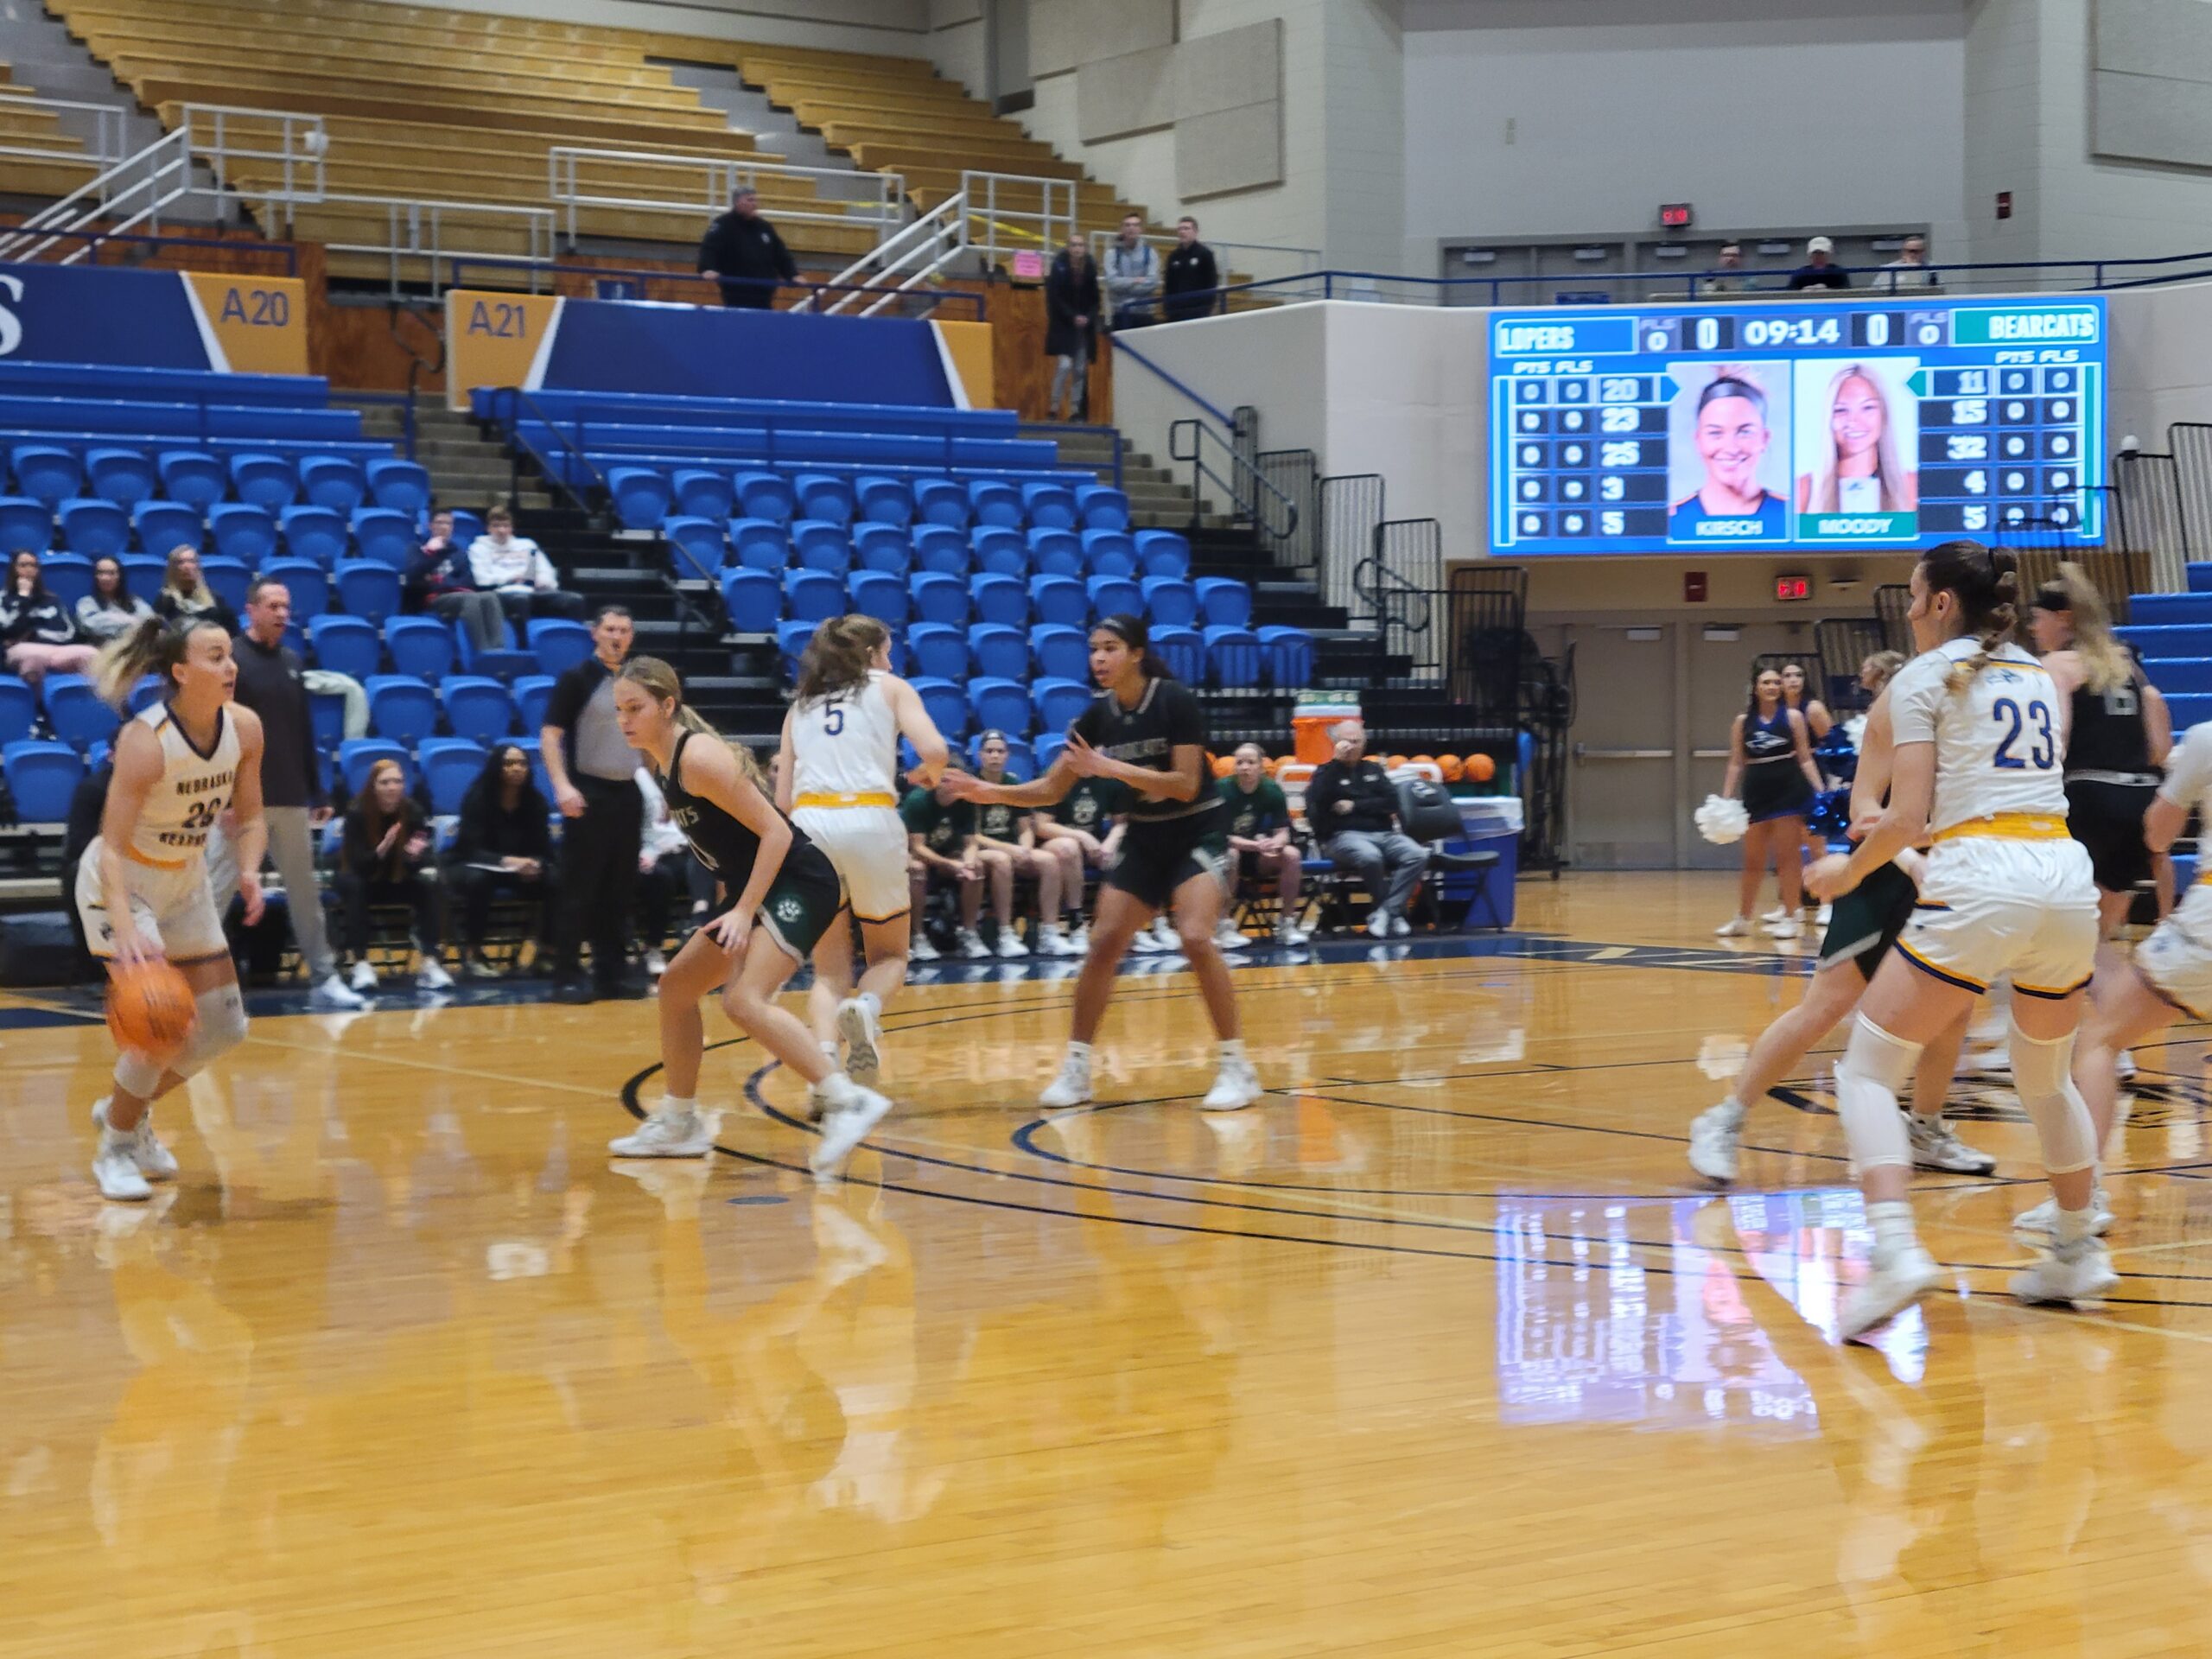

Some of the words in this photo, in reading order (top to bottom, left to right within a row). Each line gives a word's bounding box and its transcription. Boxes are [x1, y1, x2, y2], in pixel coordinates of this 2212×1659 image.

[220, 288, 289, 327] A20
[467, 301, 525, 338] A21
[1696, 318, 1719, 350] 0
[1745, 318, 1840, 346] 09:14
[1866, 314, 1889, 346] 0
[1918, 325, 1940, 345] 0
[1989, 313, 2095, 340] BEARCATS
[1647, 331, 1669, 352] 0
[1513, 361, 1552, 374] PTS
[1555, 359, 1593, 373] FLS
[1994, 350, 2035, 364] PTS
[2039, 349, 2080, 363] FLS
[1602, 378, 1639, 401] 20
[1958, 371, 1986, 394] 11
[1952, 399, 1987, 424] 15
[1947, 435, 1987, 460] 32
[1601, 476, 1624, 500] 3
[1963, 470, 1986, 493] 4
[1601, 511, 1624, 535] 5
[1696, 519, 1764, 537] KIRSCH
[1818, 518, 1893, 535] MOODY
[1963, 505, 1987, 530] 5
[824, 696, 844, 736] 5
[1993, 697, 2055, 770] 23
